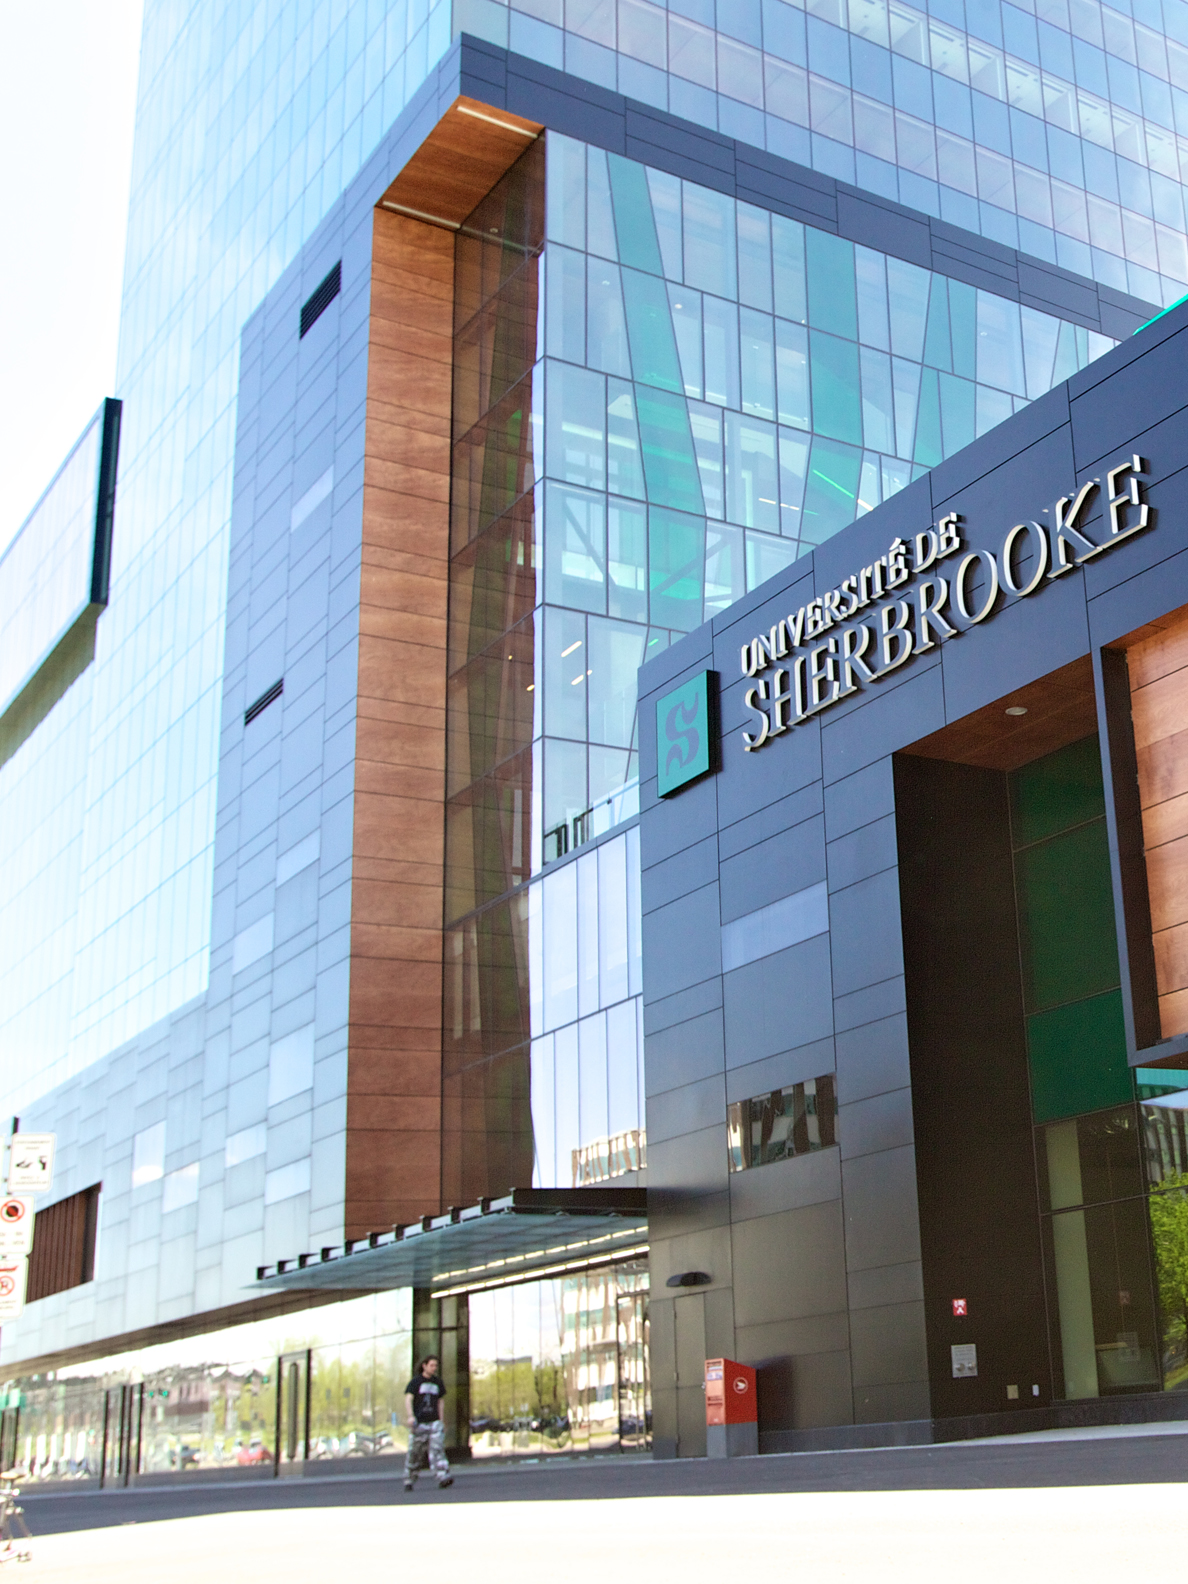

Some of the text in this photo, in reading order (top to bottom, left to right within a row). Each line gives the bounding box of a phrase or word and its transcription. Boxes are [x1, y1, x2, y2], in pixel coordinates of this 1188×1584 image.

[739, 511, 961, 677] UNIVERSITÉ DE
[742, 454, 1150, 752] SHERBROOKE
